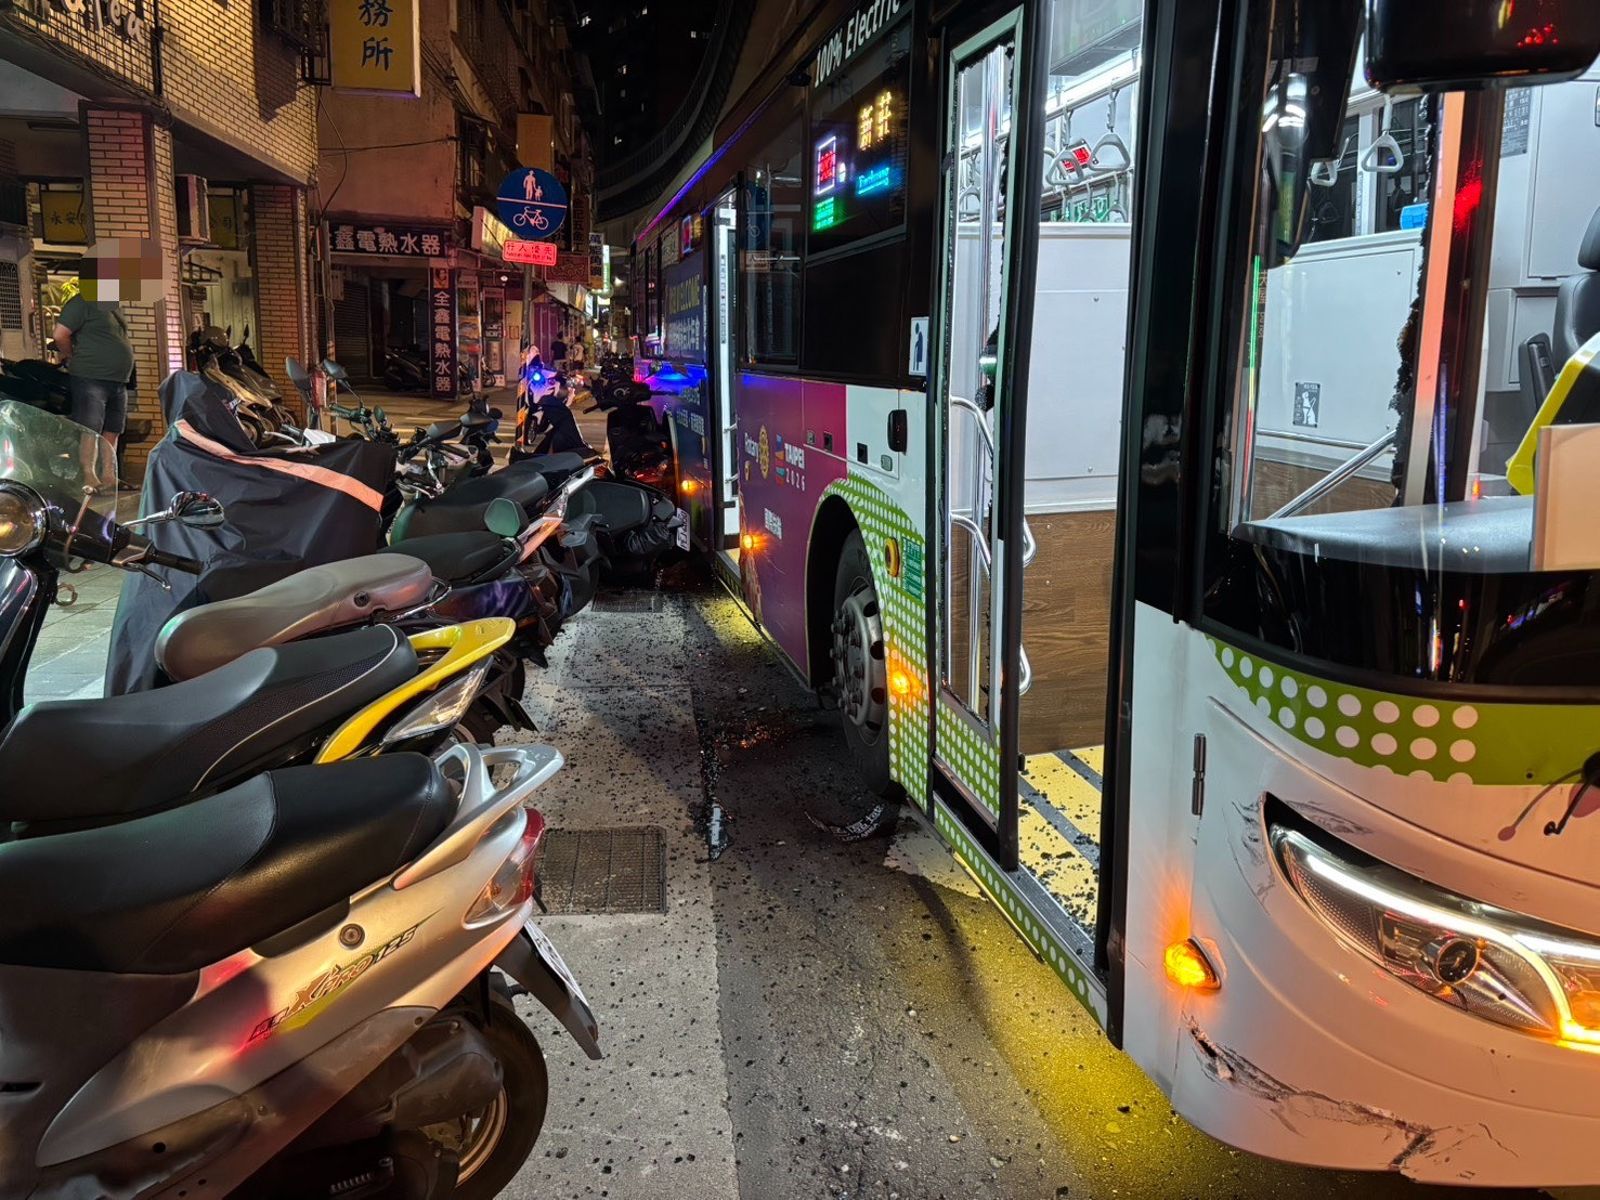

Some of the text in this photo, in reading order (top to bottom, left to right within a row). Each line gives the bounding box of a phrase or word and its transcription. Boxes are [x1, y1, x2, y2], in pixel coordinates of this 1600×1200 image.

[358, 0, 394, 71] 務所
[814, 0, 900, 88] 100% Electric
[329, 226, 441, 255] 鑫電熱水器
[507, 242, 552, 255] 行人優先
[433, 292, 451, 392] 全鑫電熱水器
[784, 443, 805, 469] TAIPEI
[375, 926, 418, 963] 125
